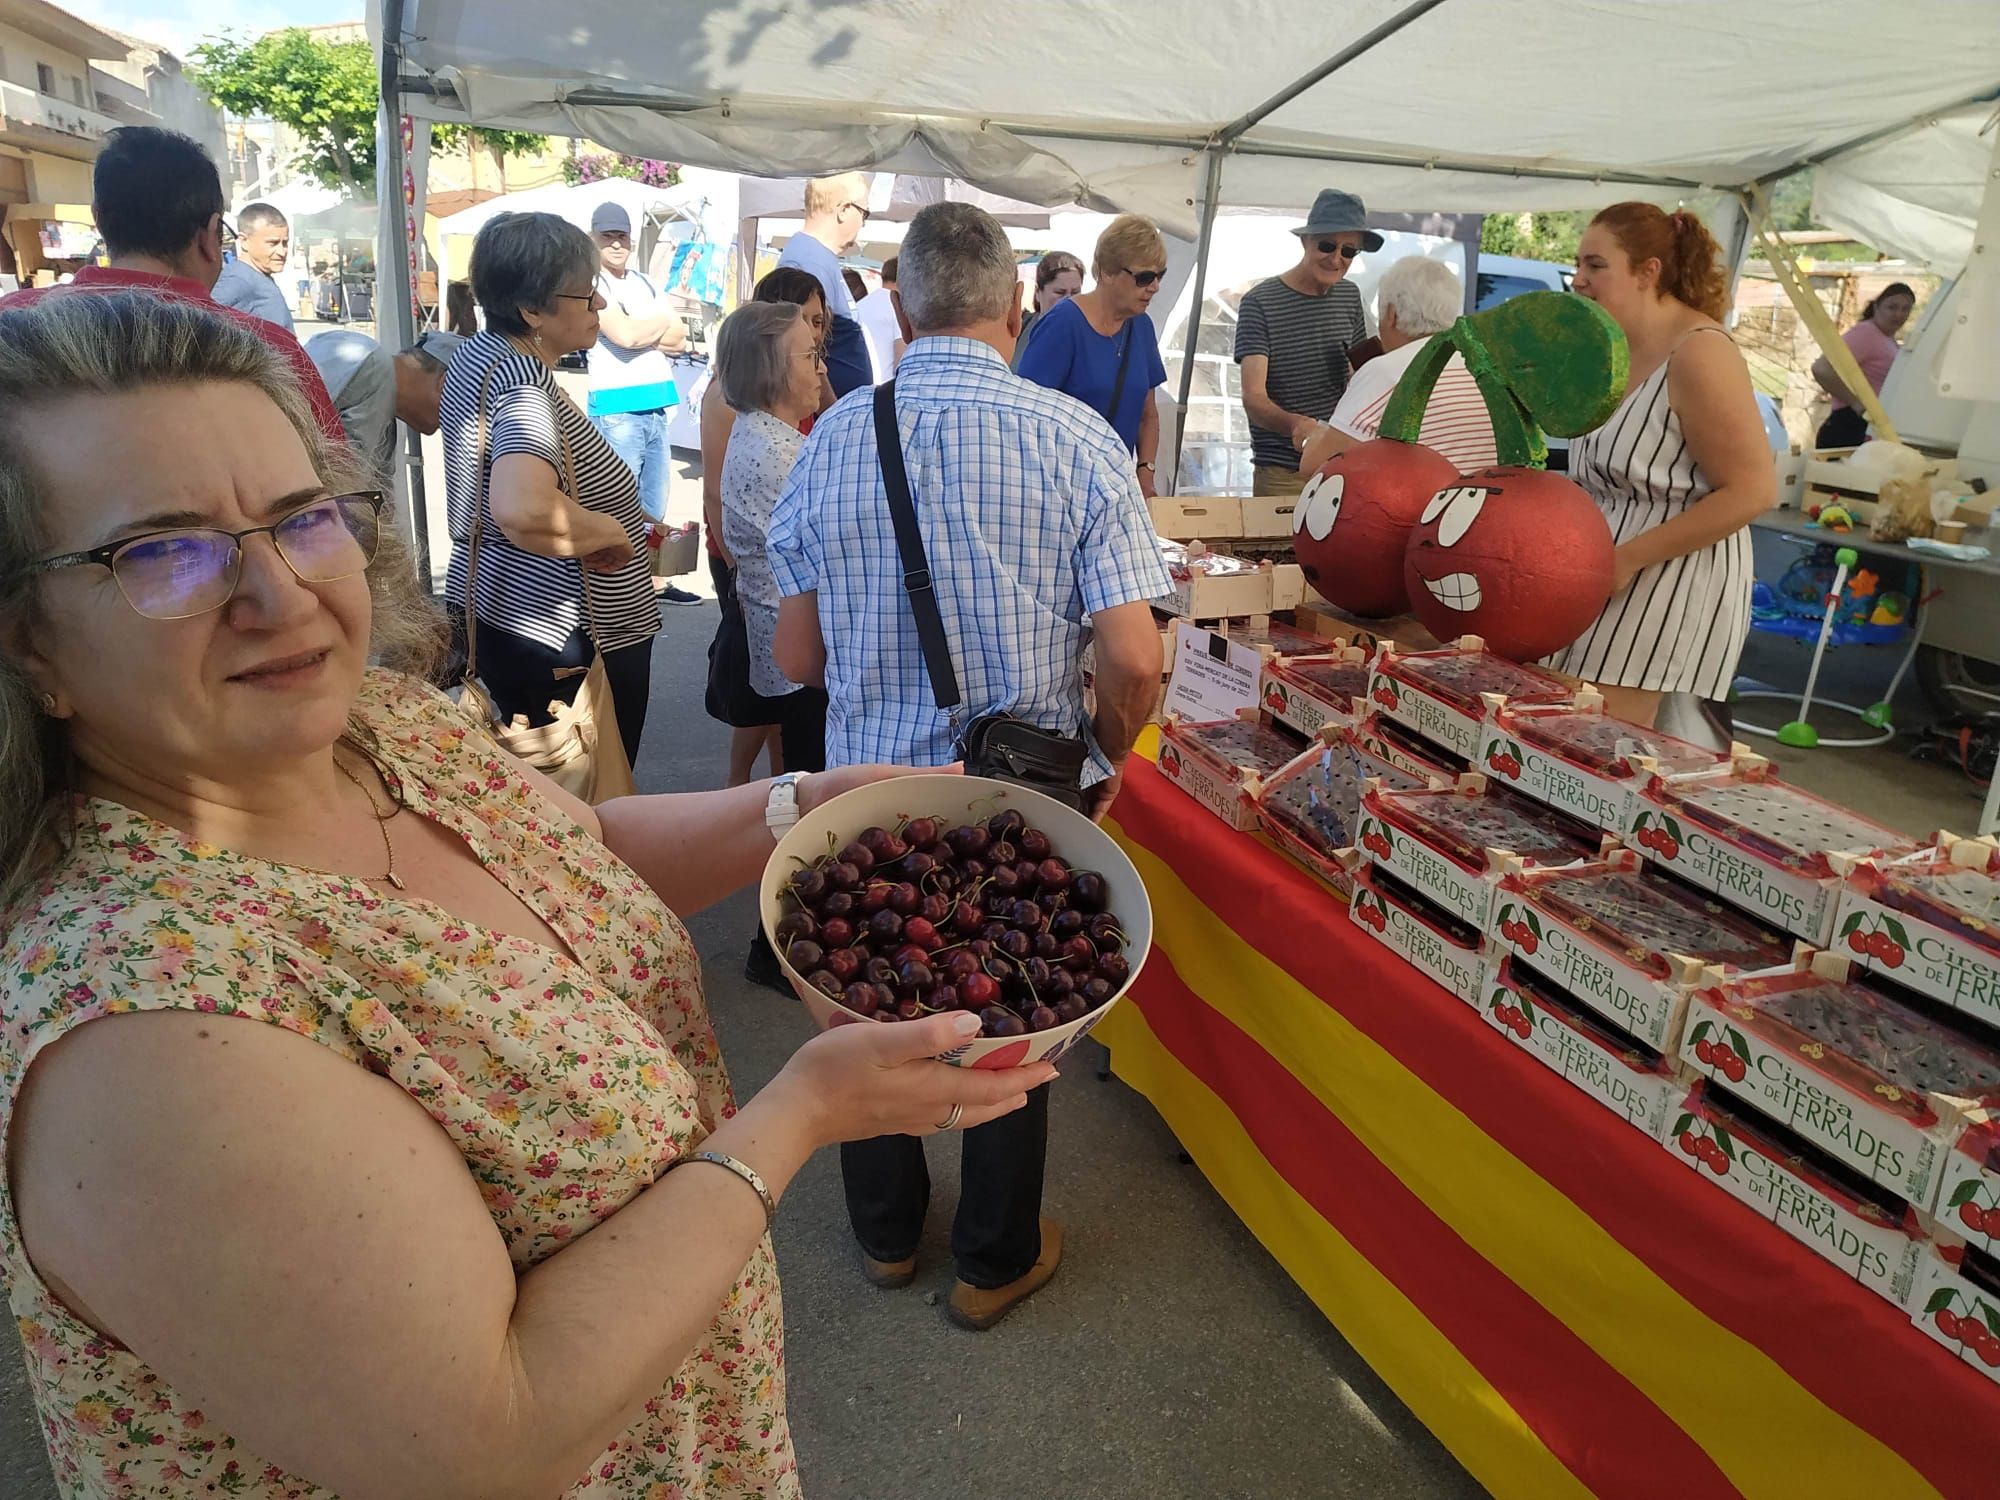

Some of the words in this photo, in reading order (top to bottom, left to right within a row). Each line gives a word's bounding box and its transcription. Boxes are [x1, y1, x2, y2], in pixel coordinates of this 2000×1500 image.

[1290, 695, 1325, 721] Cirera
[1403, 690, 1446, 719] Cirera
[1414, 704, 1470, 748] TERRADES
[1183, 760, 1214, 788] Cirera
[1393, 755, 1431, 780] Cirer
[1527, 755, 1584, 789] Cirera
[1191, 774, 1231, 815] TERRADES
[1542, 772, 1616, 822] TERRADES
[1397, 837, 1448, 875] Cirera
[1687, 834, 1764, 879] Cirera
[1410, 855, 1474, 911] TERRADES
[1707, 855, 1804, 921] TERRADES
[1391, 911, 1442, 952] Cirera
[1546, 929, 1614, 980] Cirera
[1404, 929, 1469, 990] TERRADES
[1917, 938, 2000, 982] Cirer
[1564, 951, 1649, 1025] TERRADES
[1540, 1017, 1610, 1072] Cirera
[1558, 1040, 1648, 1118] TERRADES
[1757, 1055, 1854, 1120] Cirera
[1783, 1082, 1904, 1177] TERRADES
[1741, 1150, 1837, 1220] Cirera
[1766, 1178, 1888, 1278] TERRADES
